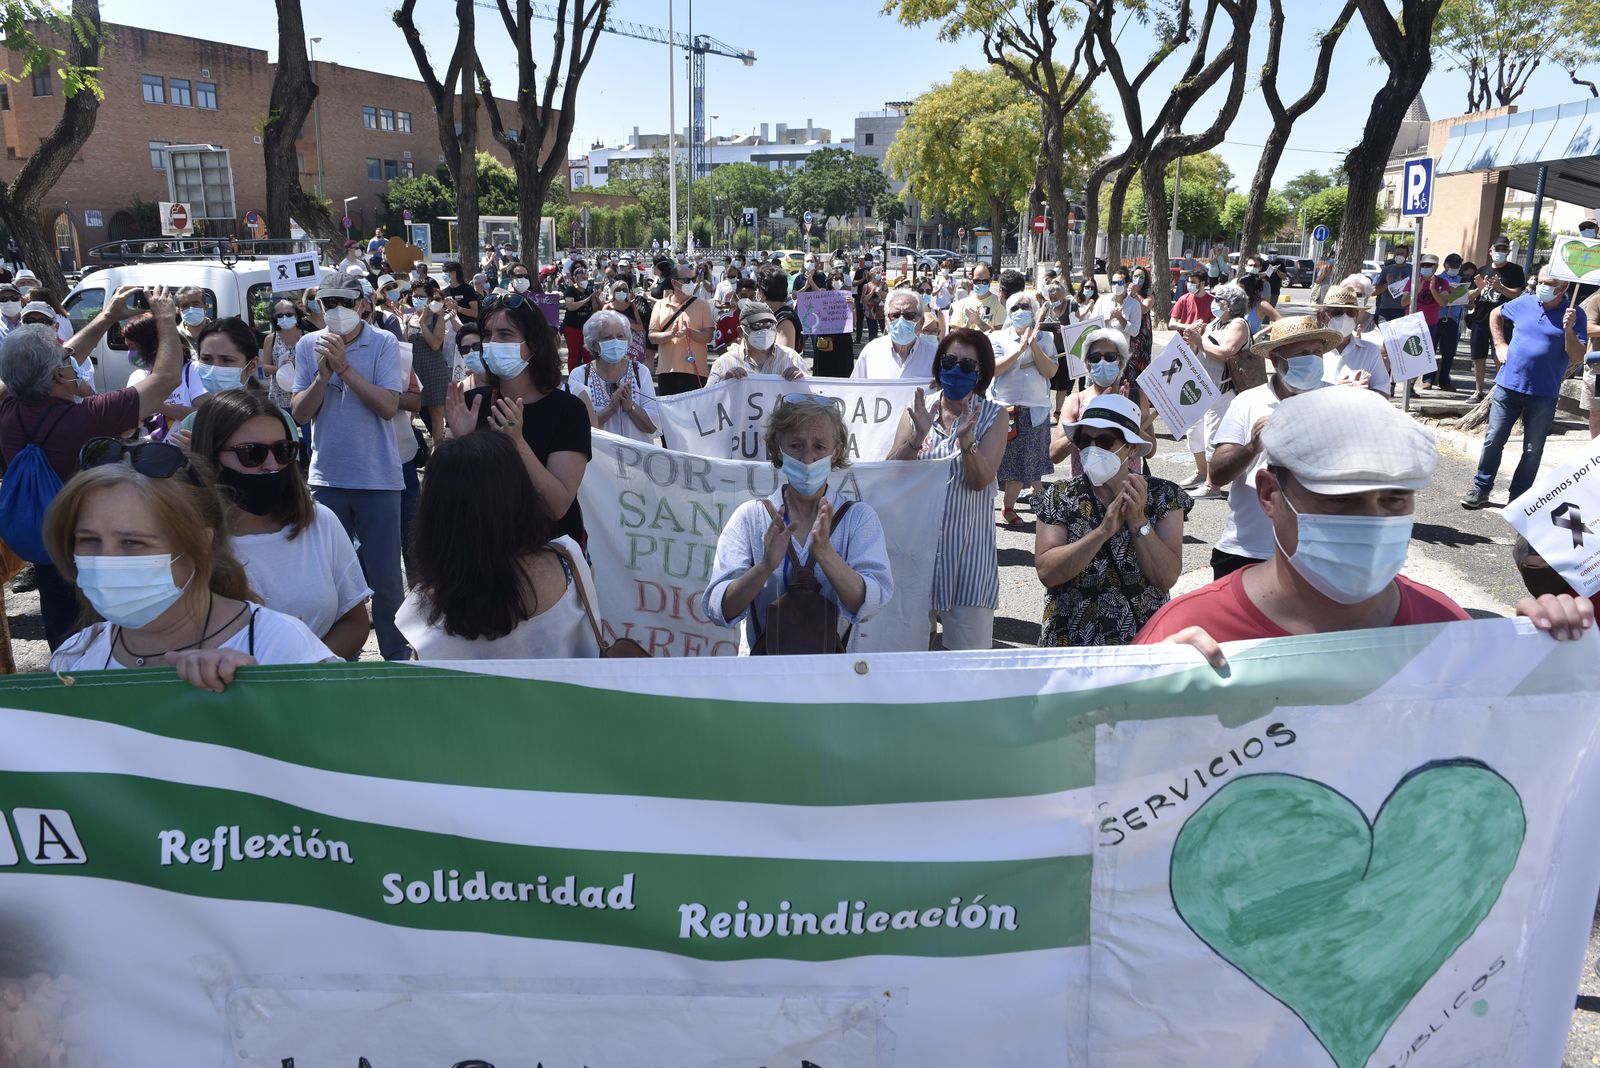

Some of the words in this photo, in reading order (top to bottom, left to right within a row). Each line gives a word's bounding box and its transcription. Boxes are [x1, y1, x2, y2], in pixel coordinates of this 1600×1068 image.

[1407, 164, 1427, 210] P
[692, 402, 733, 437] LA
[1523, 478, 1573, 518] Luchemos
[1573, 462, 1591, 484] por
[1098, 722, 1297, 847] SERVICIOS
[158, 825, 354, 872] Reflexión
[381, 868, 637, 912] Solidaridad
[678, 894, 1020, 940] Reivindicación
